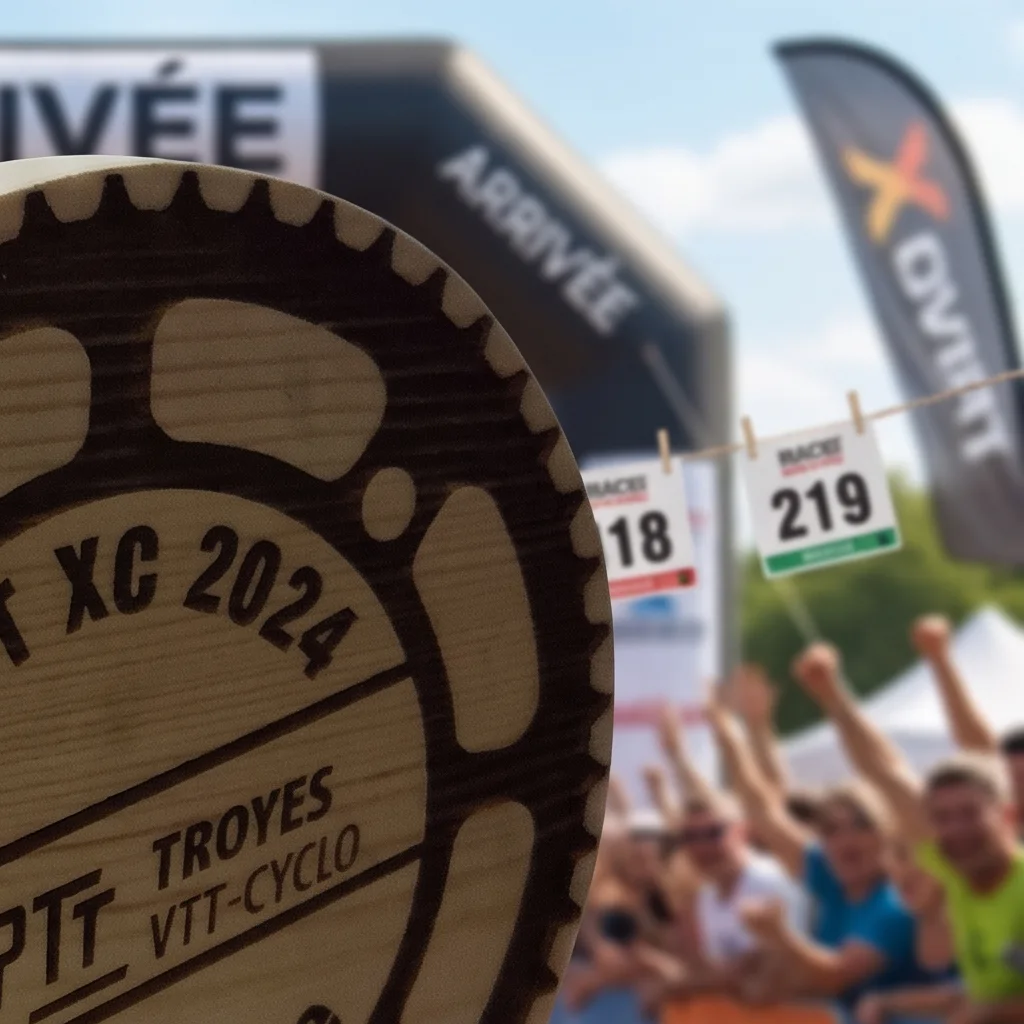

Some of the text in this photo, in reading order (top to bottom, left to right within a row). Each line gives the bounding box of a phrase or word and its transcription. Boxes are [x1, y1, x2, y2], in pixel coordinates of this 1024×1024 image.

[438, 144, 641, 335] ARRIVÉE
[605, 510, 674, 568] 18
[771, 472, 872, 542] 219
[54, 525, 159, 634] XC
[183, 525, 359, 680] 2024
[150, 824, 361, 959] VTT-CYCLO
[151, 766, 335, 890] TROYES
